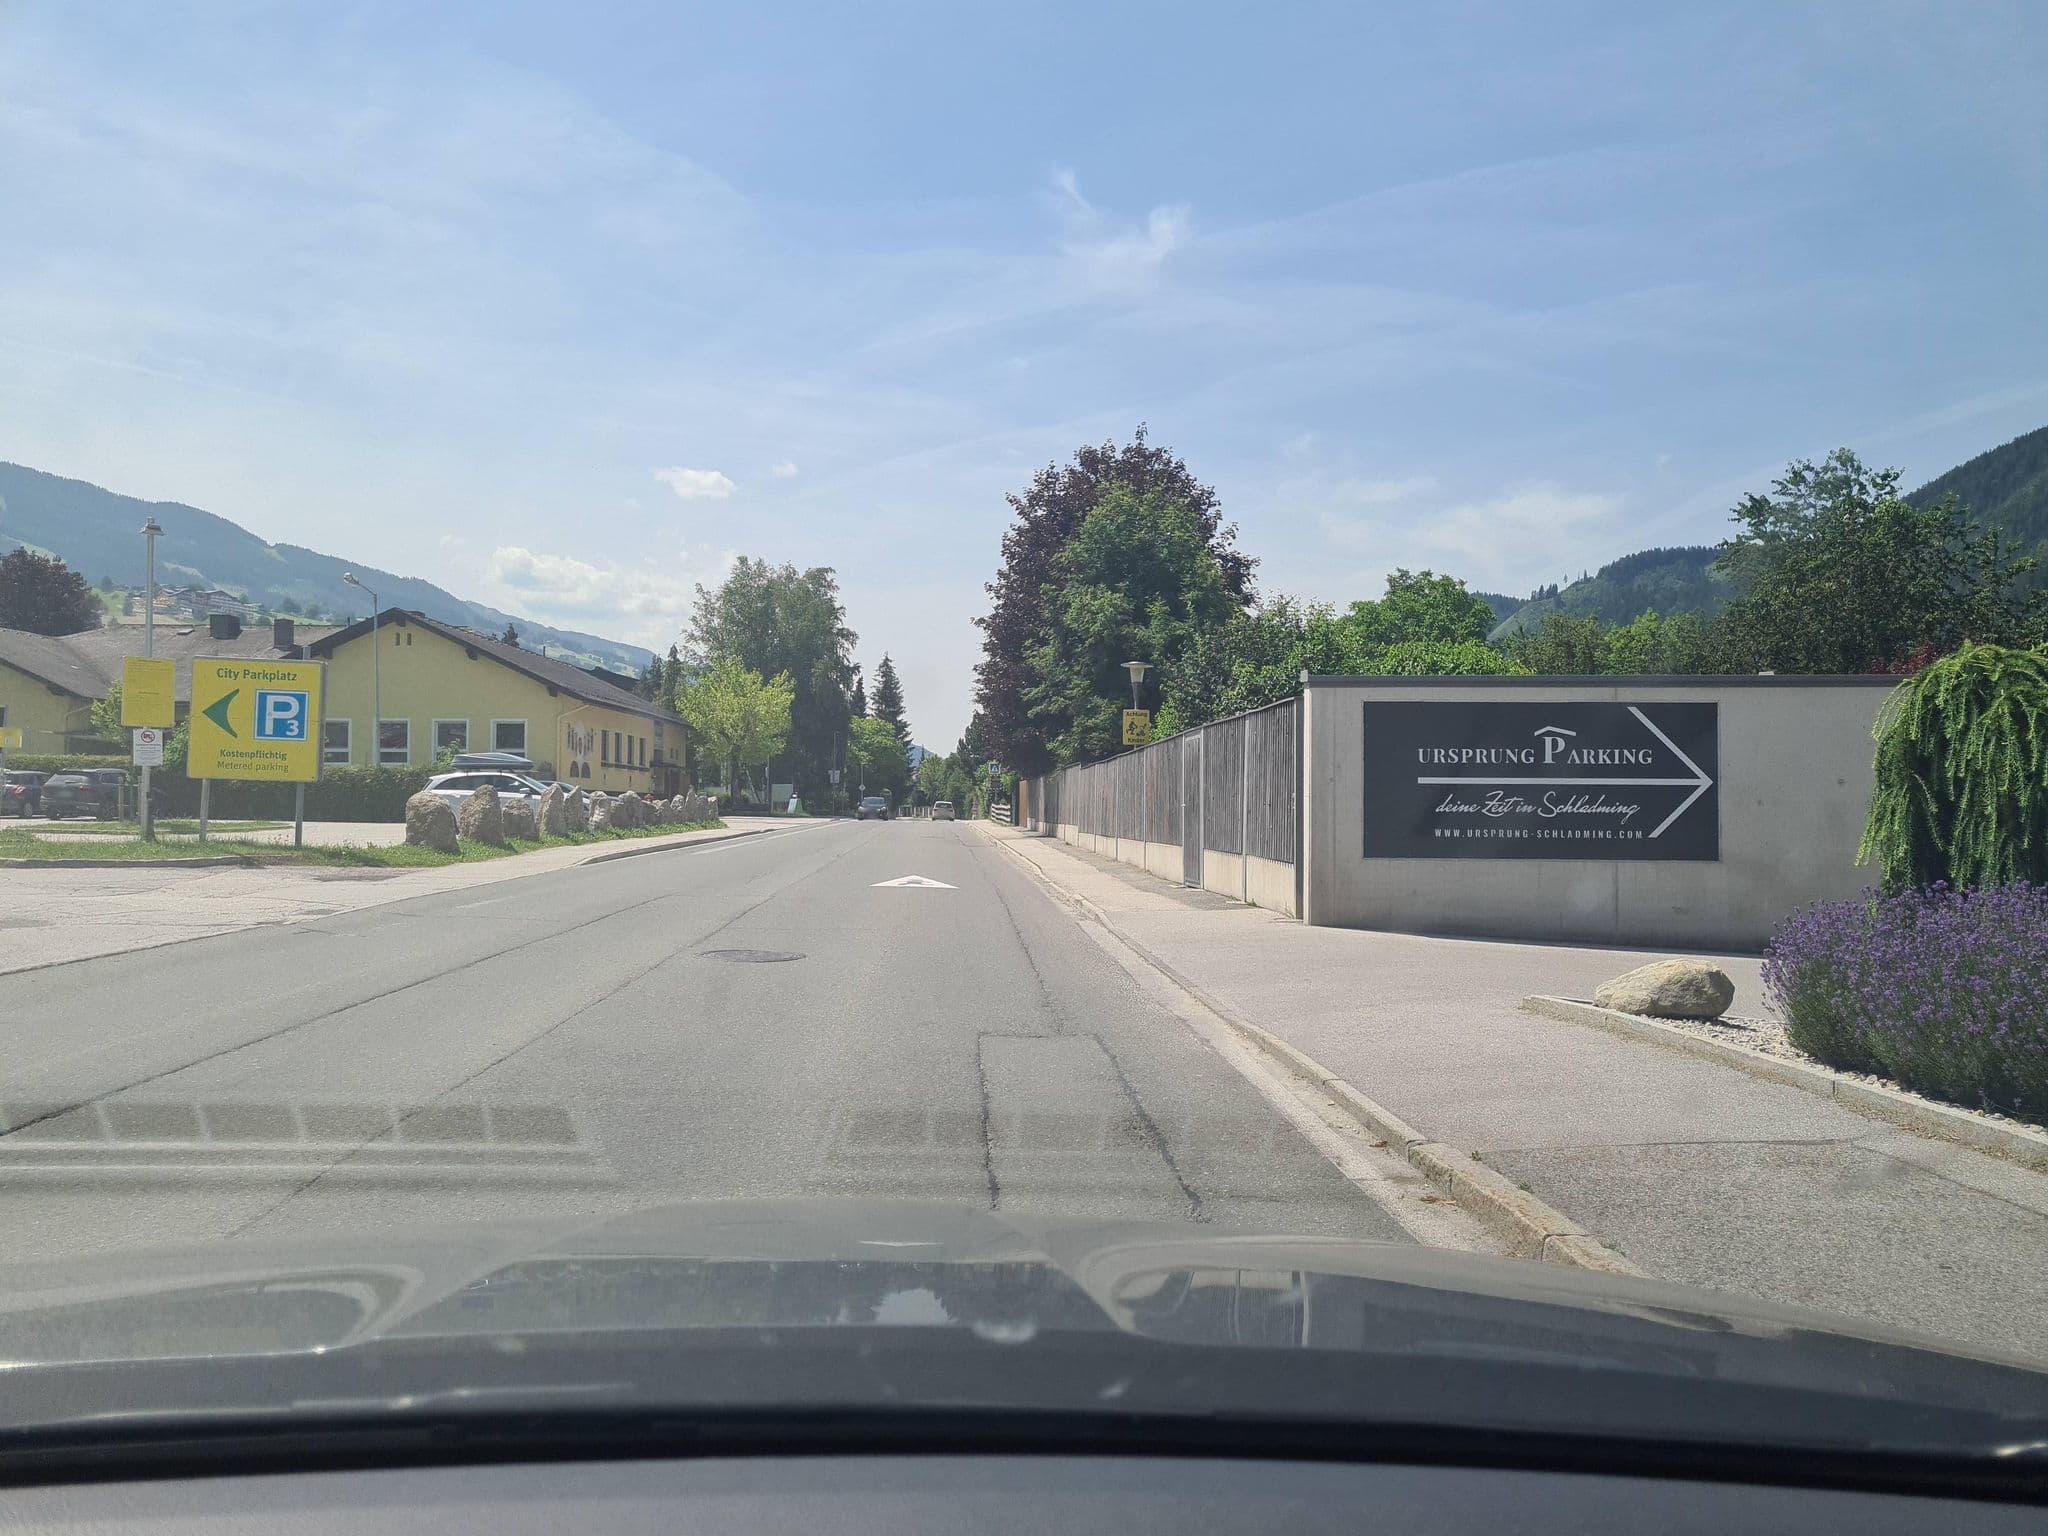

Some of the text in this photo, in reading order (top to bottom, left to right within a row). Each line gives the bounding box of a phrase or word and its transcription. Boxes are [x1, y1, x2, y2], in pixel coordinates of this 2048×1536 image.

[216, 668, 298, 683] City Parkplatz
[219, 749, 288, 761] Kostenpflichtig
[1418, 748, 1535, 764] URSPRUNG
[217, 760, 289, 773] Metered parking
[1435, 790, 1641, 825] deine Zeit in Schladming
[1434, 828, 1643, 839] WWW.URSPRUNG-SCHLADMING.COM
